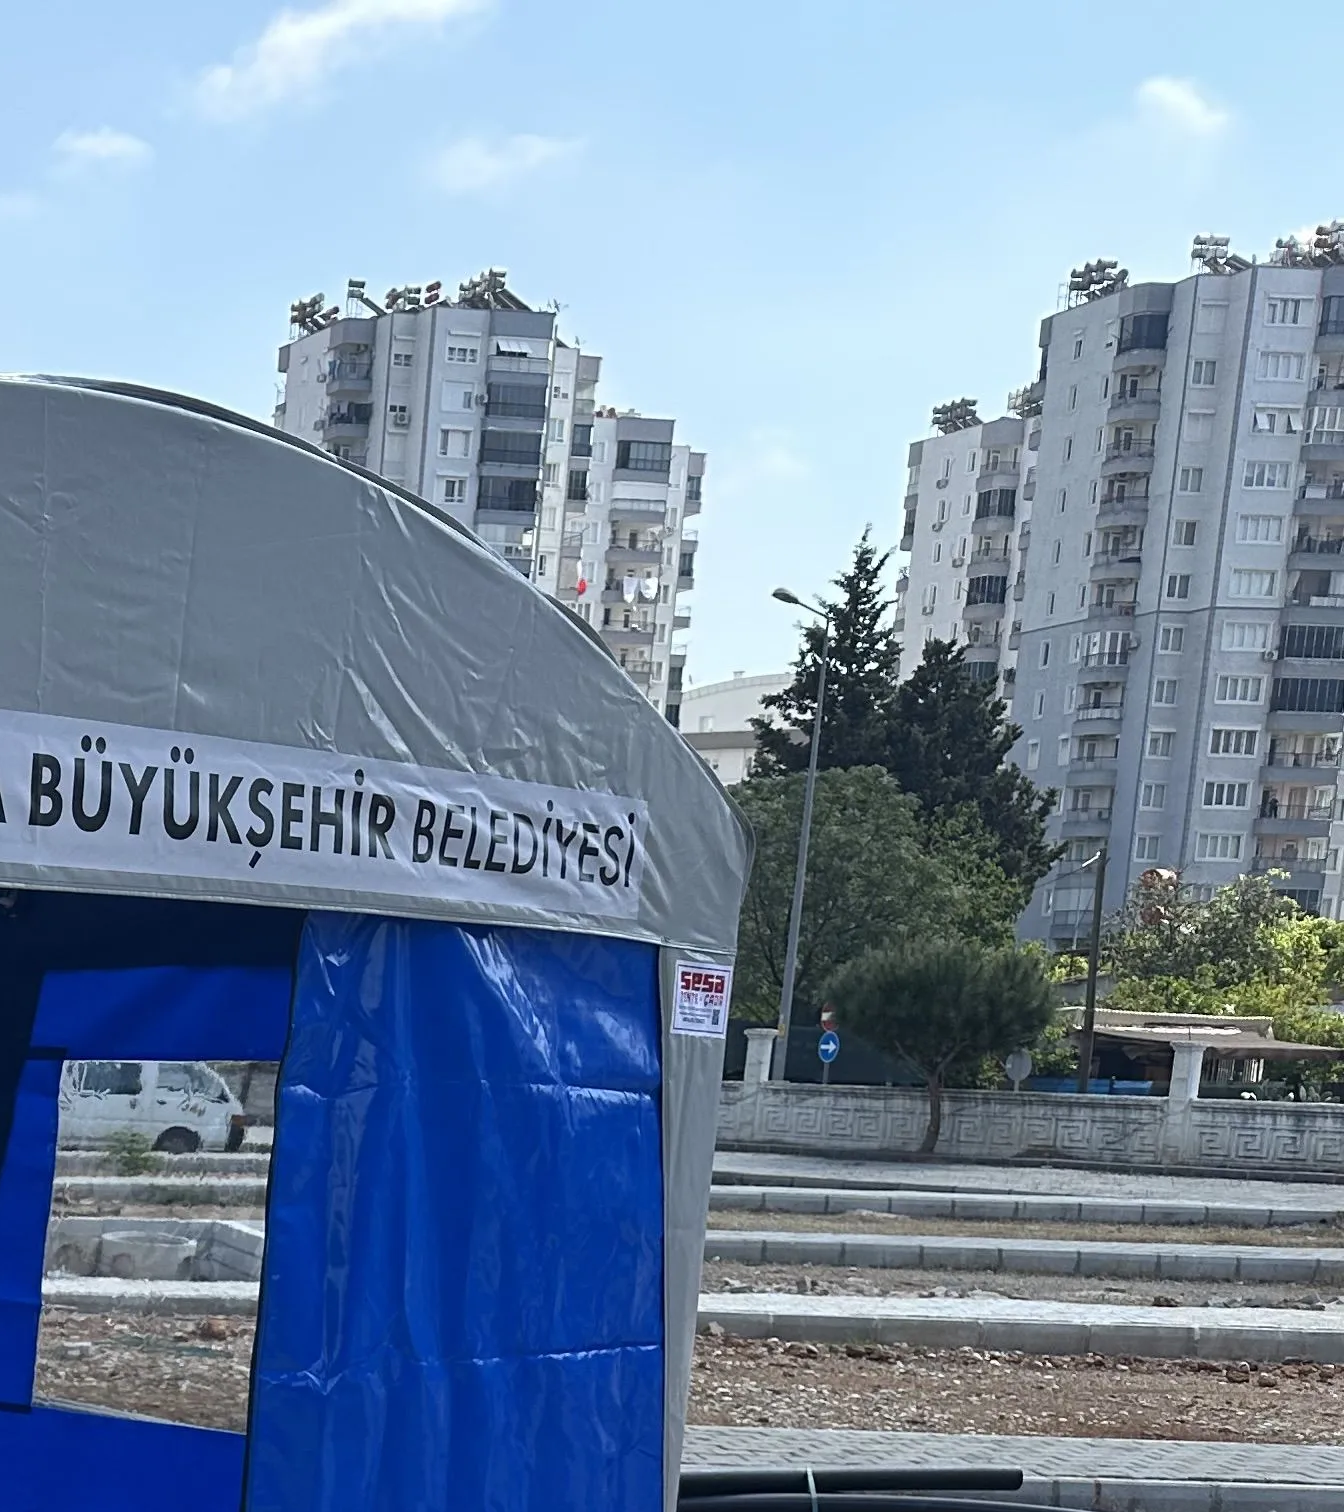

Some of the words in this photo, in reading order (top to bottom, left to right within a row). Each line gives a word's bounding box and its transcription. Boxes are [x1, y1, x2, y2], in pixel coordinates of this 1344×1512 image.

[27, 734, 396, 869] BÜYÜKŞEHİR
[411, 799, 637, 889] BELEDİYESİ
[680, 970, 726, 994] sesa
